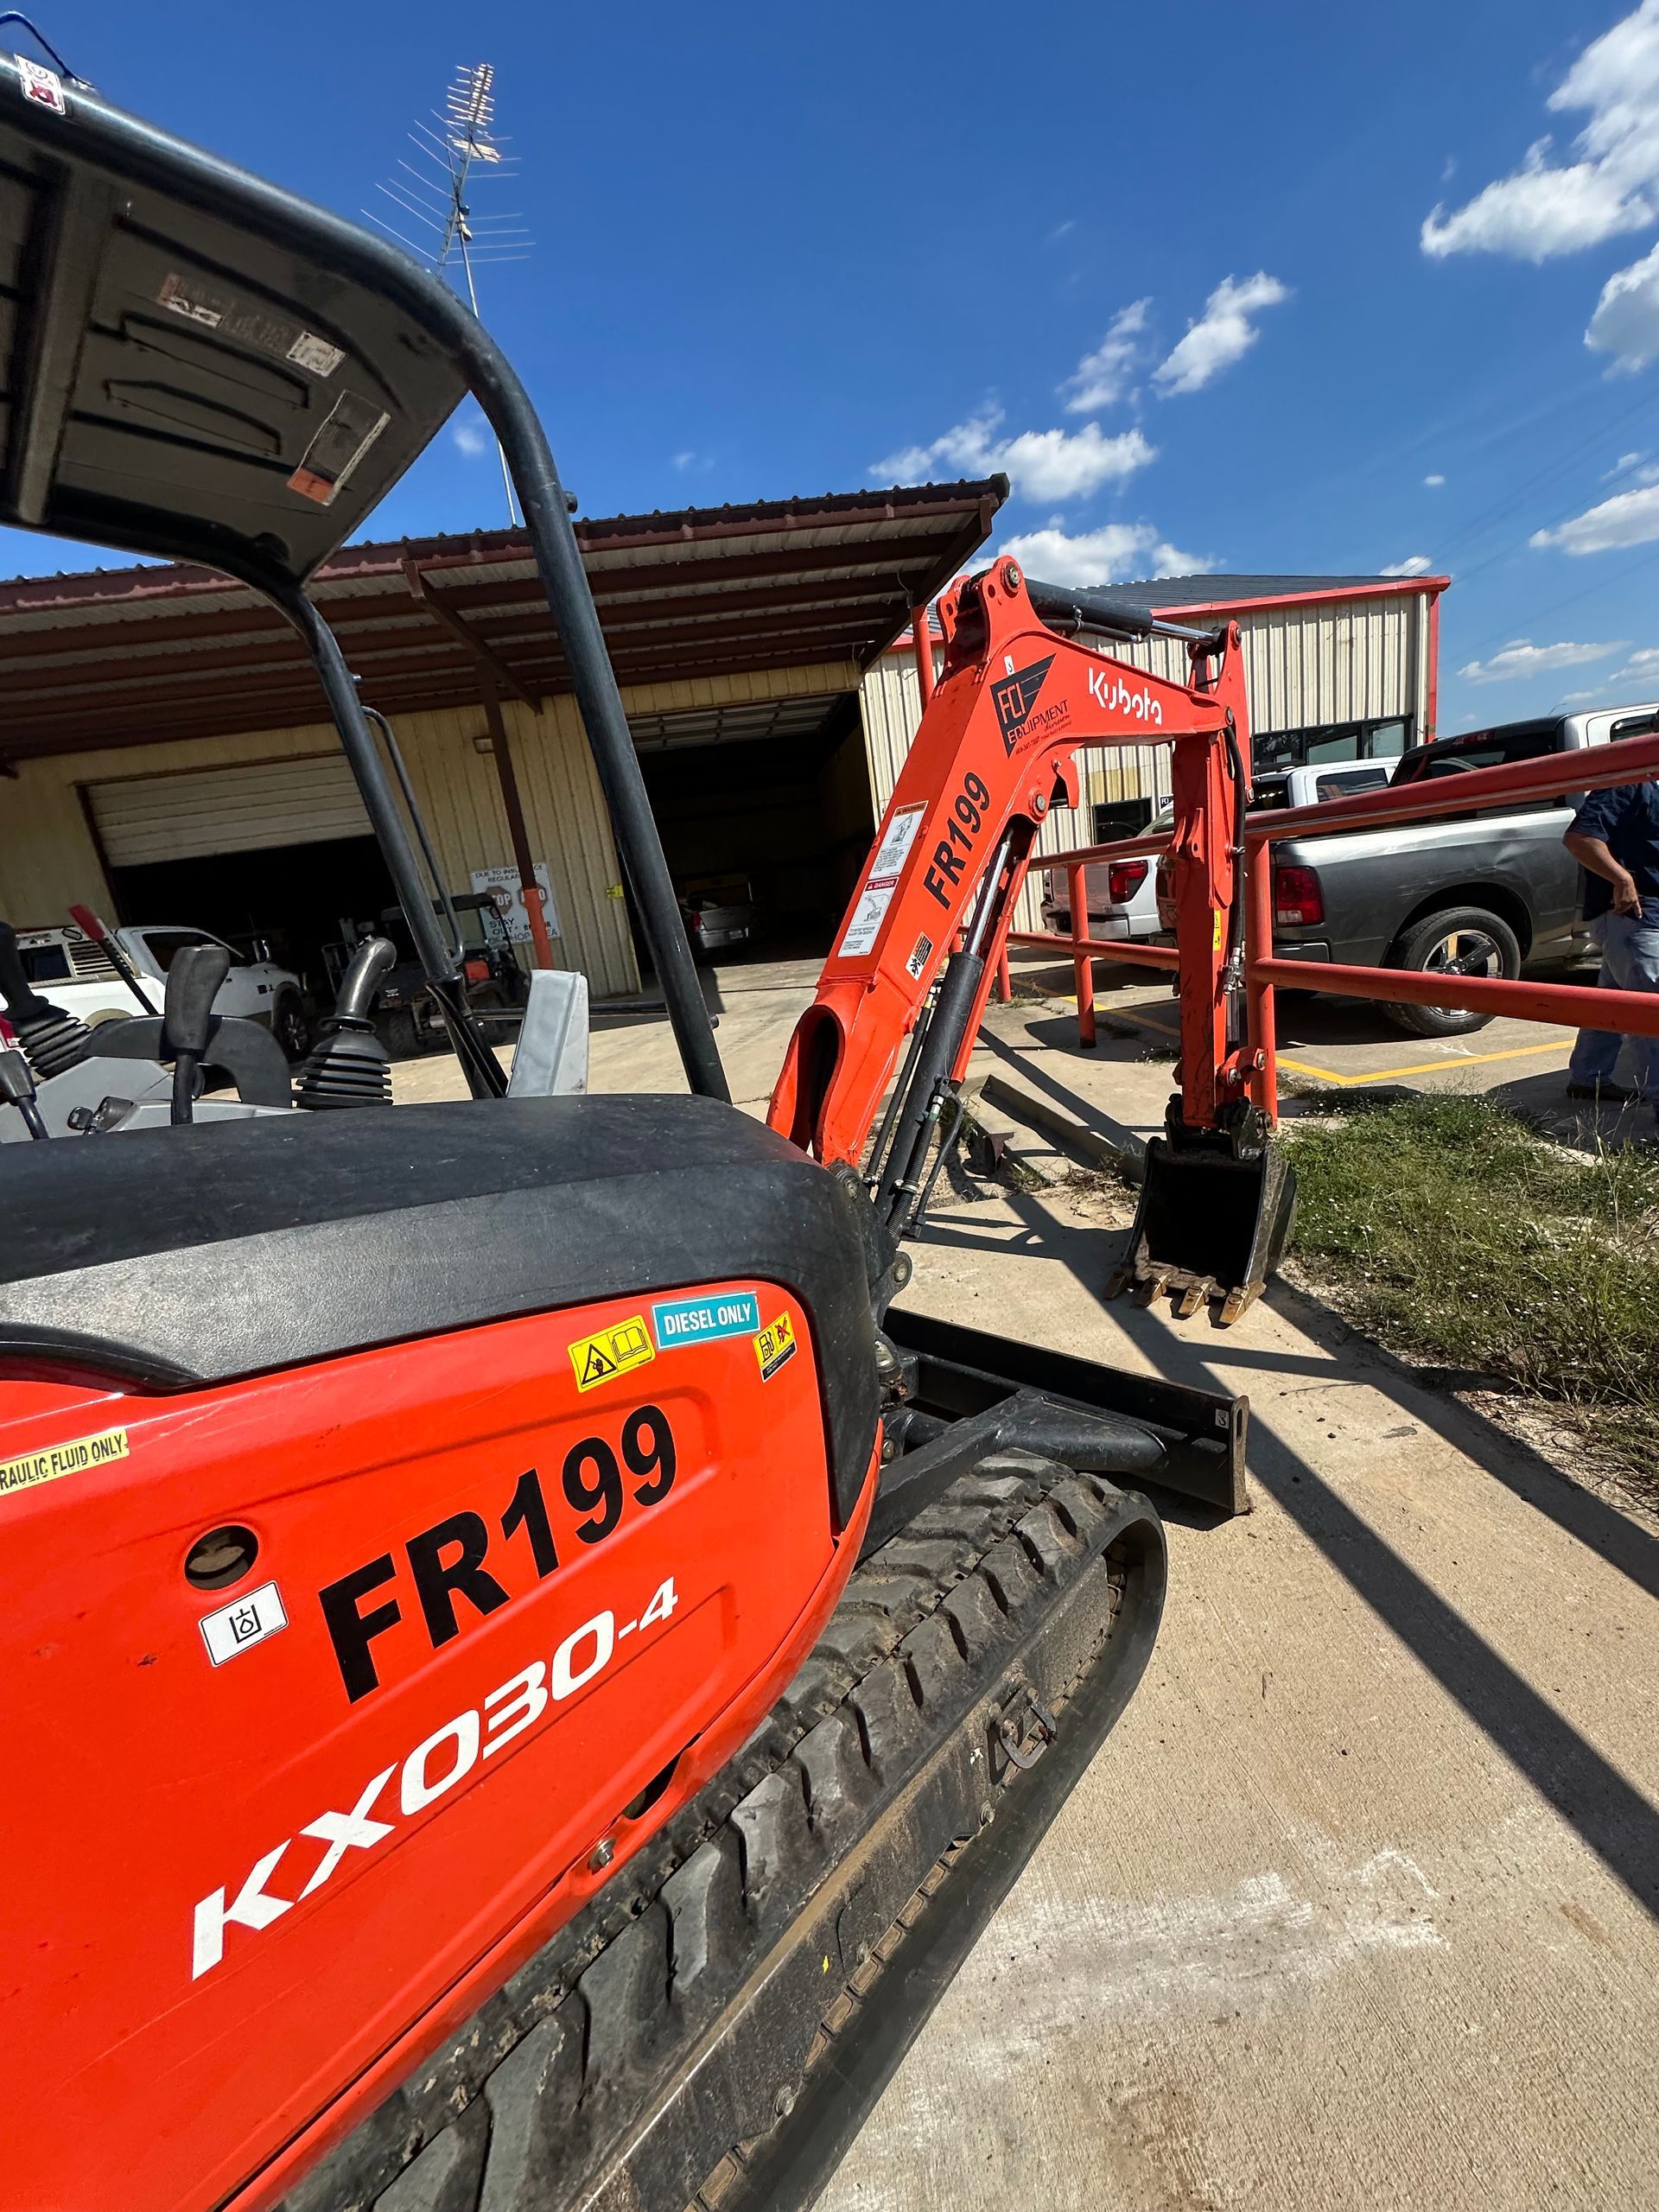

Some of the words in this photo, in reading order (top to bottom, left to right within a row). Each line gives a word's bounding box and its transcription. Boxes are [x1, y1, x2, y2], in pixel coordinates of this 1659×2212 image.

[997, 683, 1027, 724] FCI
[1007, 699, 1069, 744] EQUIPMENT
[1089, 667, 1162, 726] Kubota
[923, 772, 990, 911] FR199
[664, 1308, 716, 1336] DIESEL
[717, 1303, 752, 1326] ONLY
[50, 1445, 89, 1474] FLUID
[91, 1433, 123, 1462] ONLY
[317, 1404, 677, 1705] FR199
[191, 1576, 678, 1981] KX030-4
